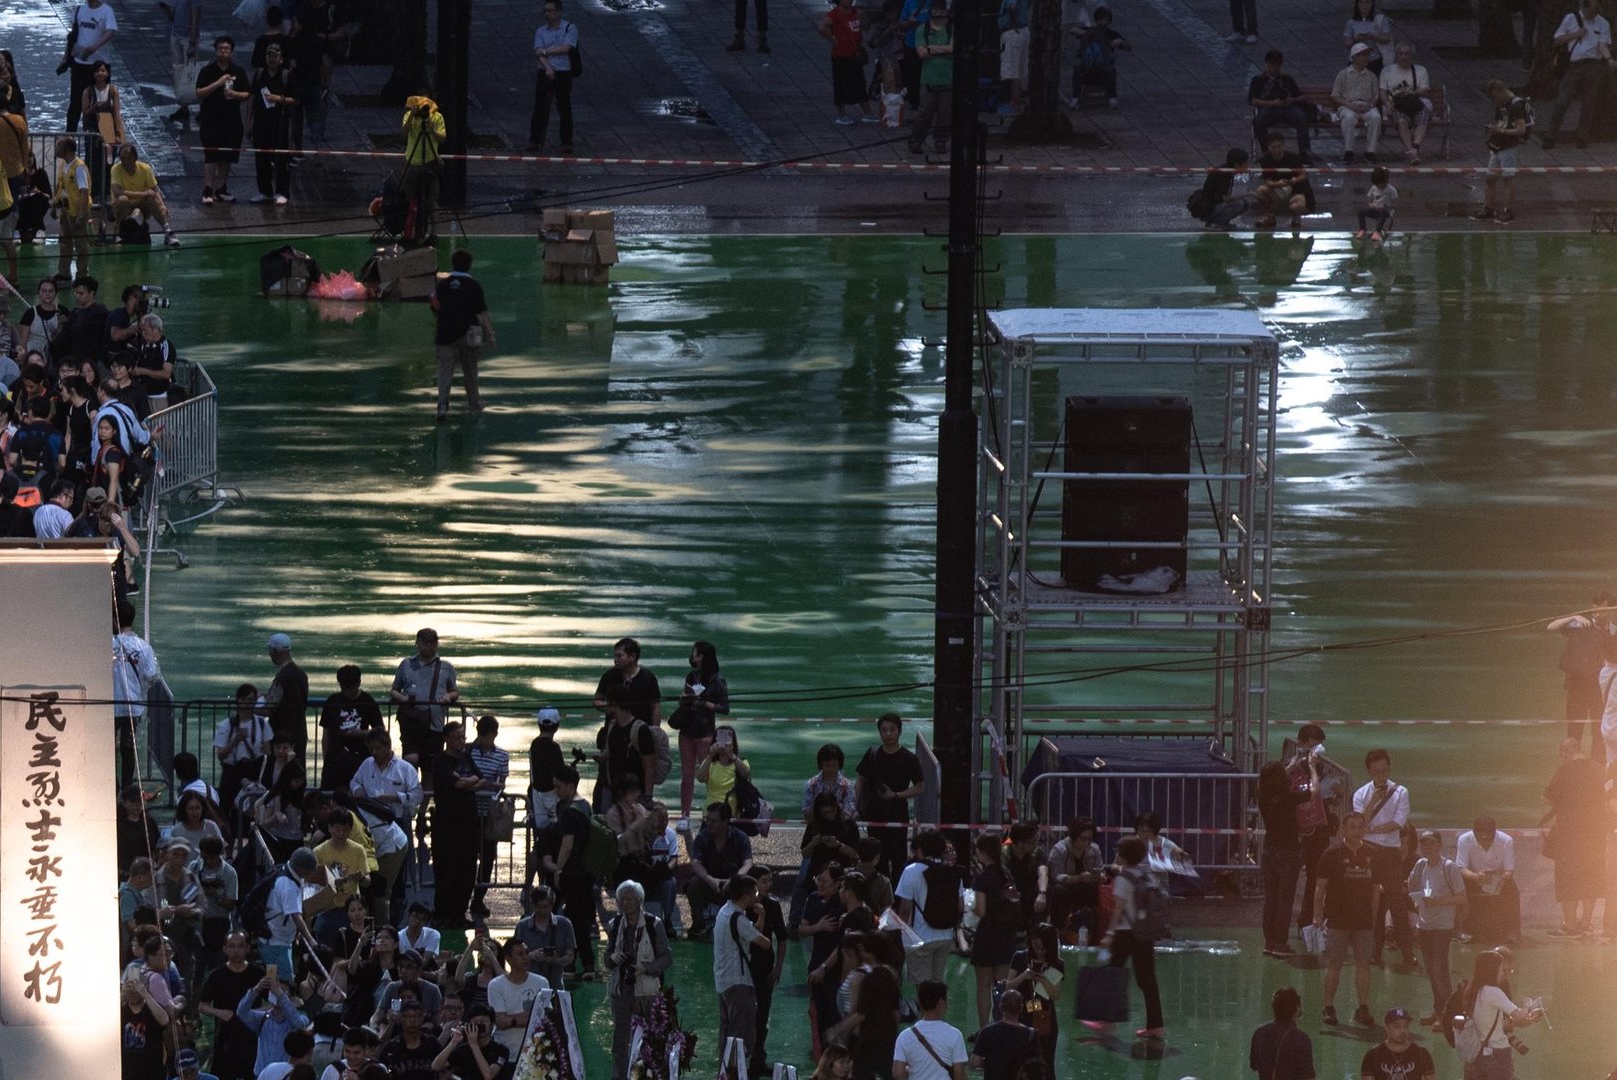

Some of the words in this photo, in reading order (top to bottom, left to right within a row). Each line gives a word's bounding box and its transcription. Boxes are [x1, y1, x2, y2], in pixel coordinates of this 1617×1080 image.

[21, 691, 66, 1004] 民主烈士永垂不朽
